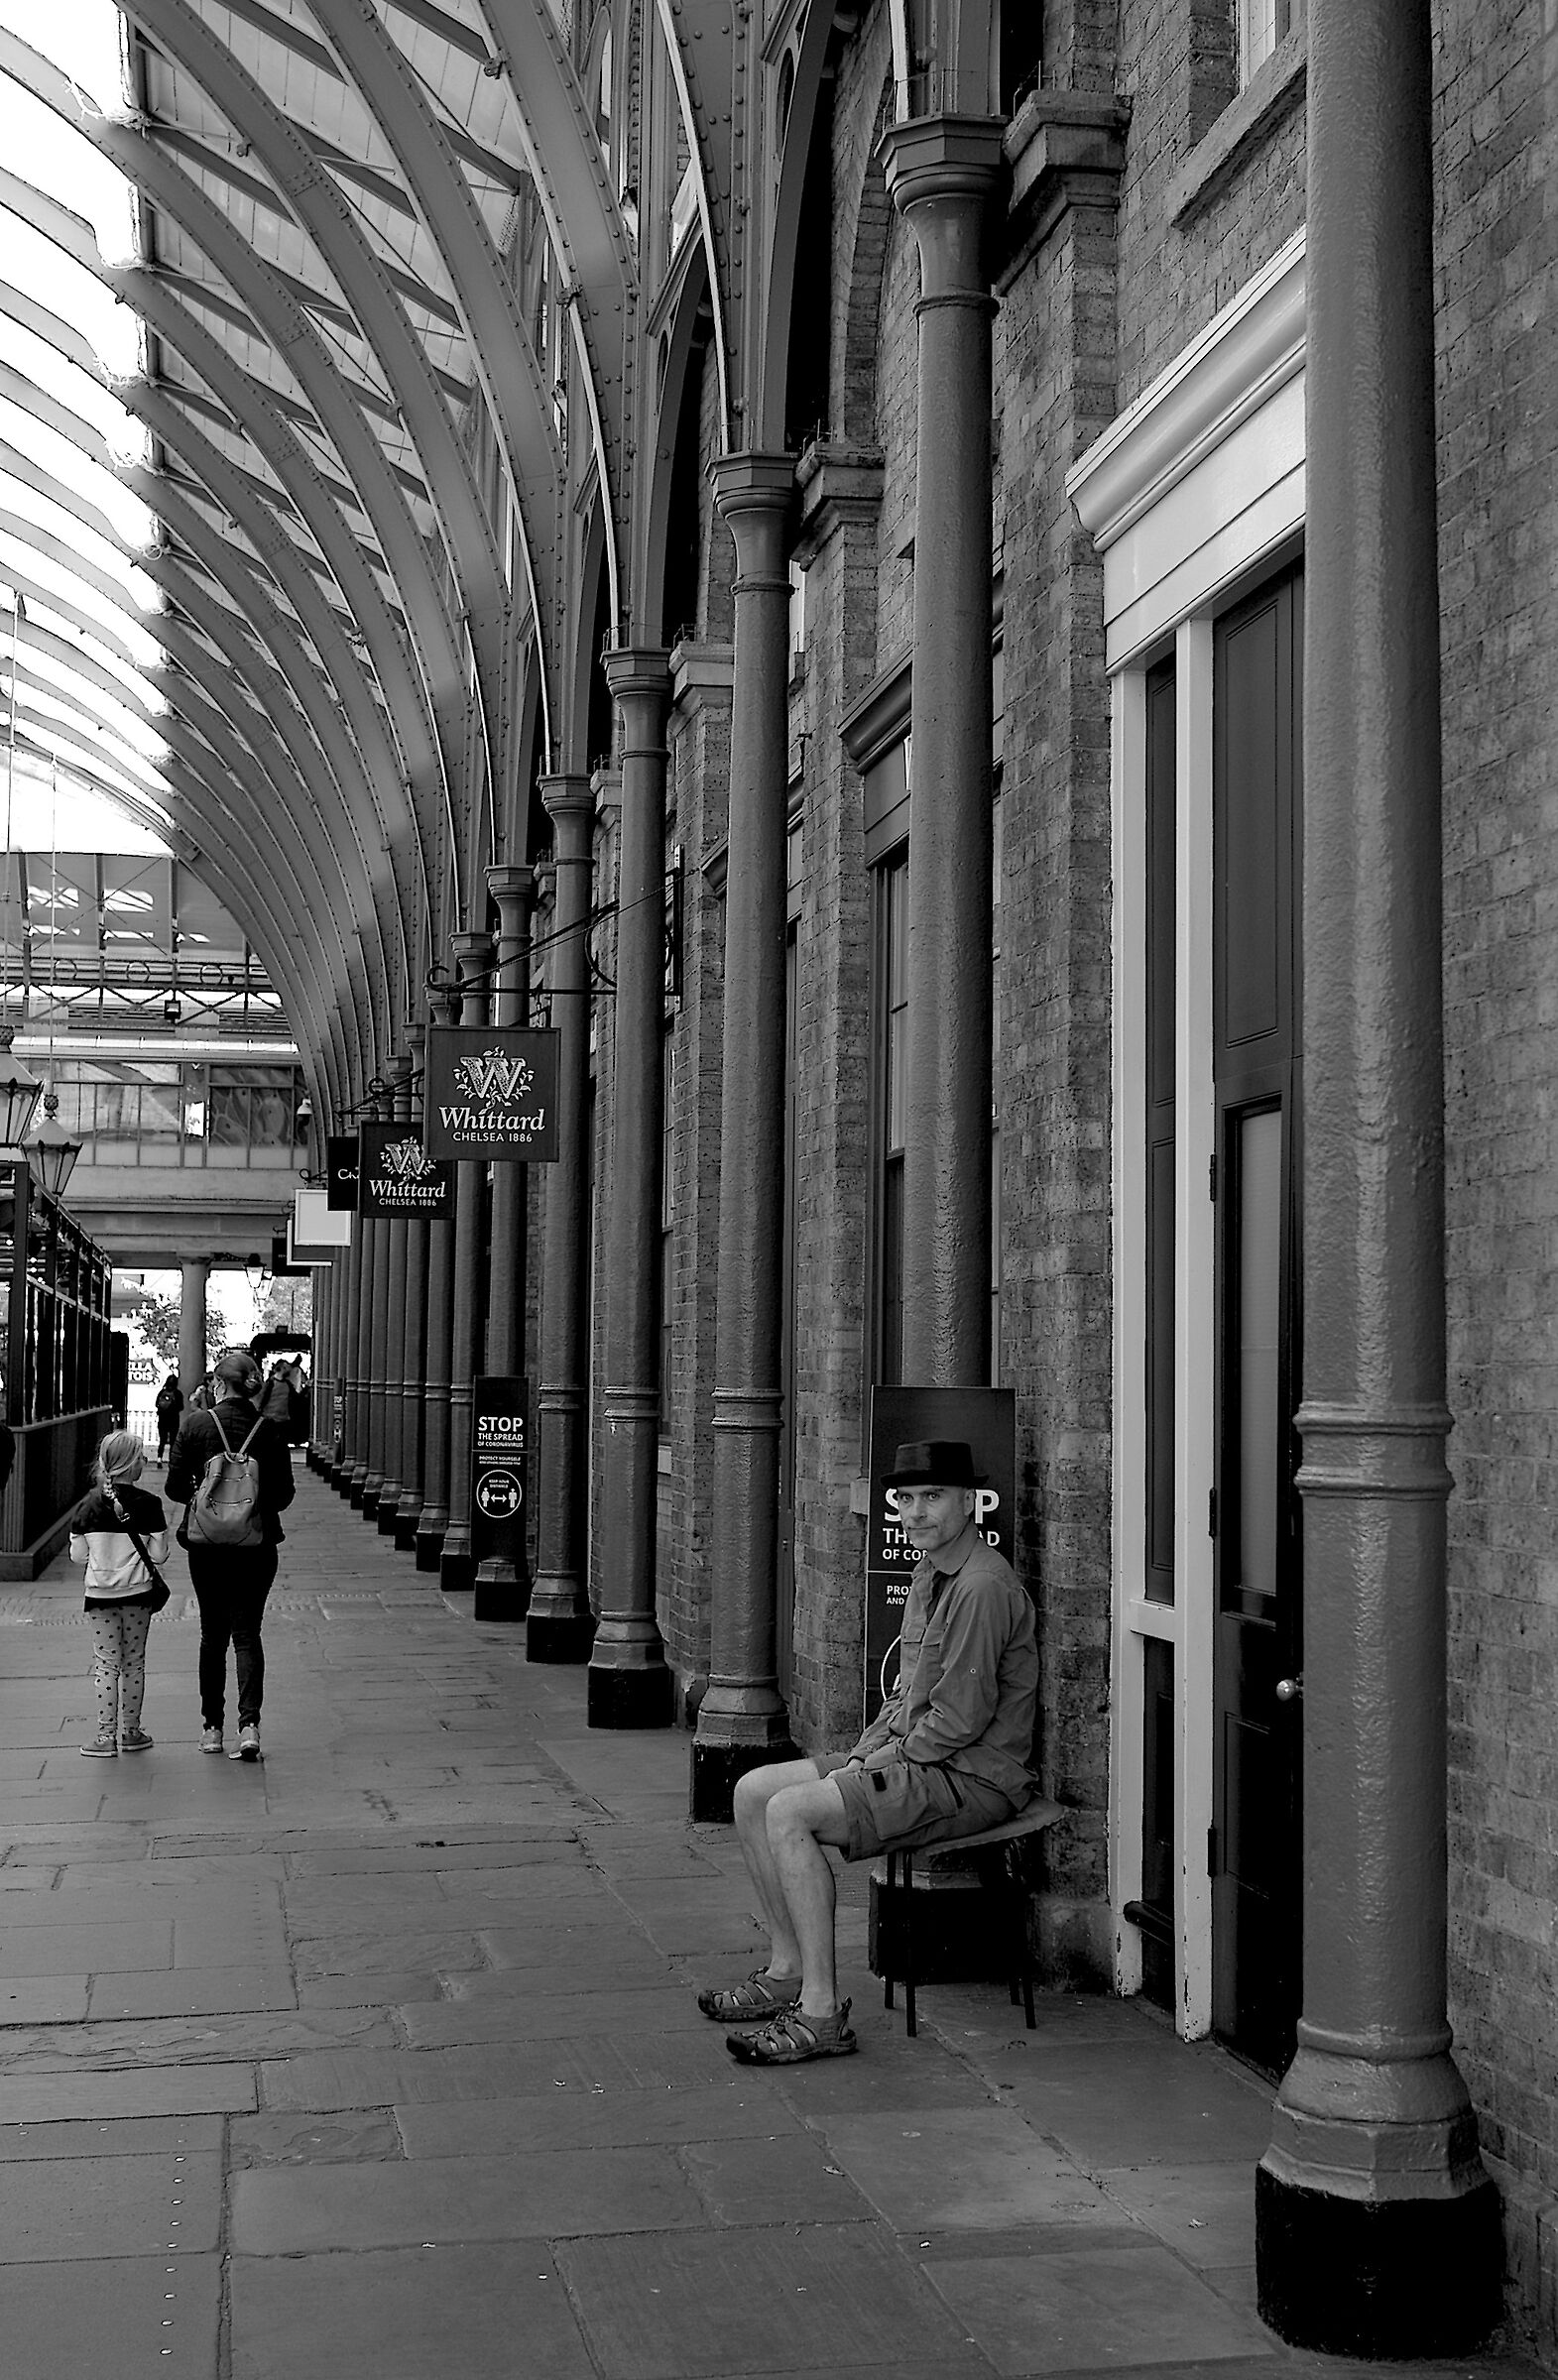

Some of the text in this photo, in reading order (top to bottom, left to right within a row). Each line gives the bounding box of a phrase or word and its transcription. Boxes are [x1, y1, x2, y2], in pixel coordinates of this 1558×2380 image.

[438, 1107, 545, 1130] Whittard
[452, 1132, 533, 1142] CHELSEA 1886
[369, 1179, 446, 1198] Whittard
[478, 1416, 524, 1432] STOP
[882, 1528, 914, 1545] TH
[882, 1549, 900, 1560] OF
